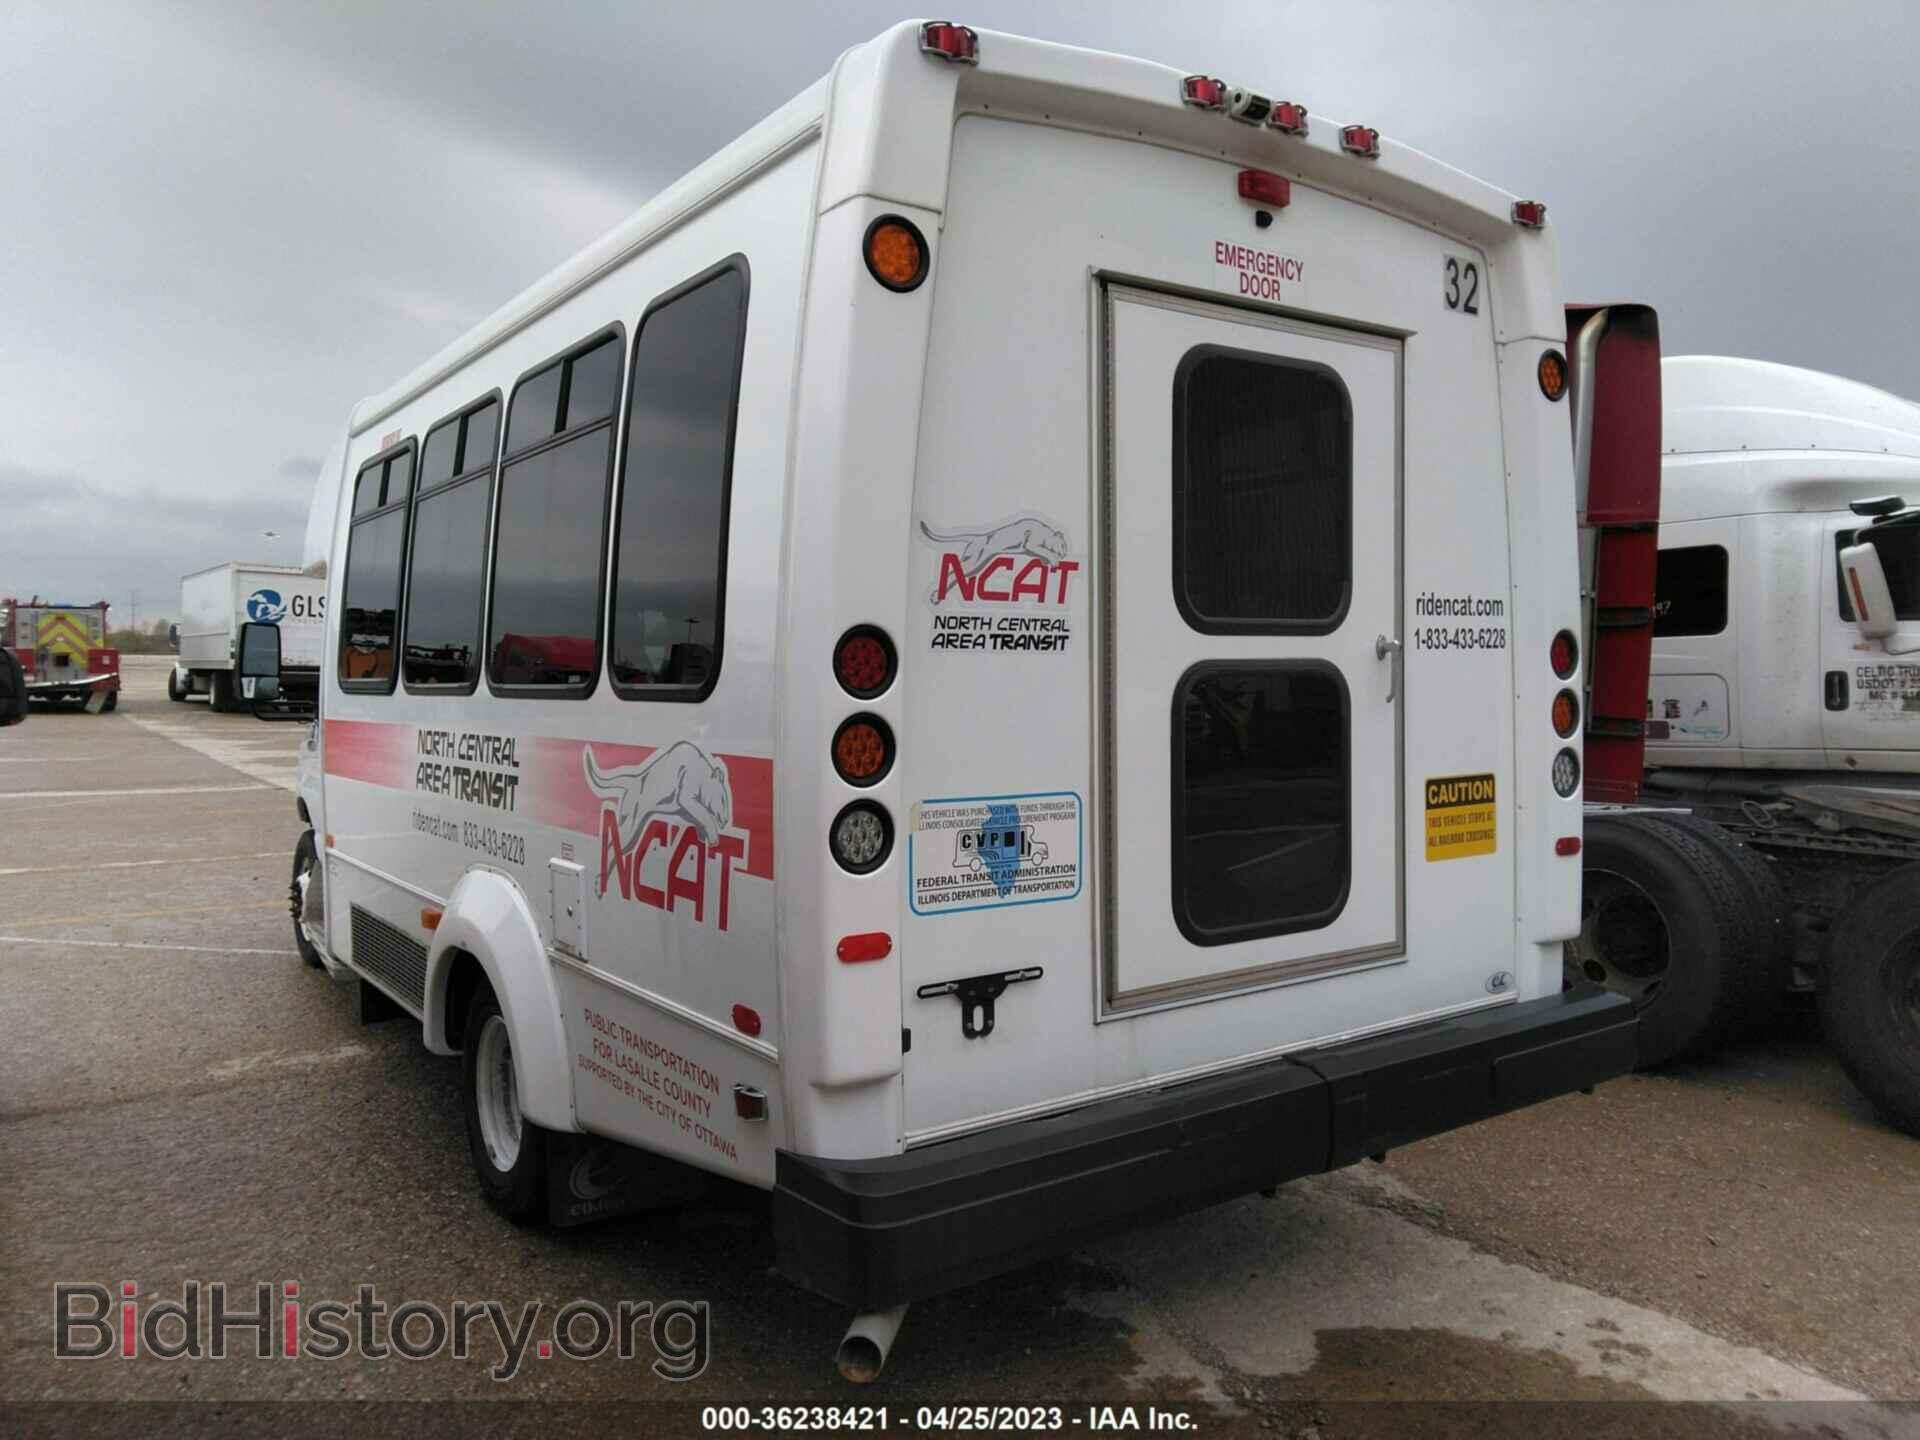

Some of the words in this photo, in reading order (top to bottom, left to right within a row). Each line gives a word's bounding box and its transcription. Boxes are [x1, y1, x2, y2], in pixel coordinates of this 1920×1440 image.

[1214, 240, 1304, 283] EMERGENCY
[1239, 272, 1282, 302] DOOR
[1445, 256, 1479, 316] 32
[937, 553, 1080, 605] NCAT
[933, 615, 992, 631] NORTH
[997, 617, 1071, 632] CENTRAL
[1415, 591, 1504, 617] ridencat.com
[931, 633, 987, 649] AREA
[989, 634, 1070, 651] TRANSIT
[1414, 627, 1507, 650] 1-833-433-6228
[416, 729, 456, 759] NORTH
[458, 733, 520, 768] CENTRAL
[415, 762, 451, 797] AREA
[452, 765, 519, 812] TRANSIT
[1428, 780, 1493, 805] CAUTION
[463, 820, 526, 866] 833-433-6228
[600, 808, 745, 932] NCAT
[916, 874, 959, 889] FEDERAL
[961, 870, 999, 884] TRANSIT
[1001, 863, 1077, 880] ADMINISTRATION
[917, 892, 950, 906] ILLINOIS
[951, 887, 1001, 902] DEPARTMENT
[1013, 880, 1076, 895] TRANSPORTATION
[583, 1008, 619, 1041] PUBLIC
[619, 1026, 721, 1096] TRANSPORTATION
[593, 1037, 613, 1062] FOR
[615, 1050, 661, 1091] LASALLE
[662, 1077, 713, 1119] COUNTY
[577, 1053, 623, 1091] SUPPORTED
[624, 1081, 637, 1098] BY
[637, 1088, 653, 1111] THE
[656, 1099, 678, 1122] CITY
[678, 1113, 694, 1133] OF
[694, 1123, 739, 1164] OTTAWA
